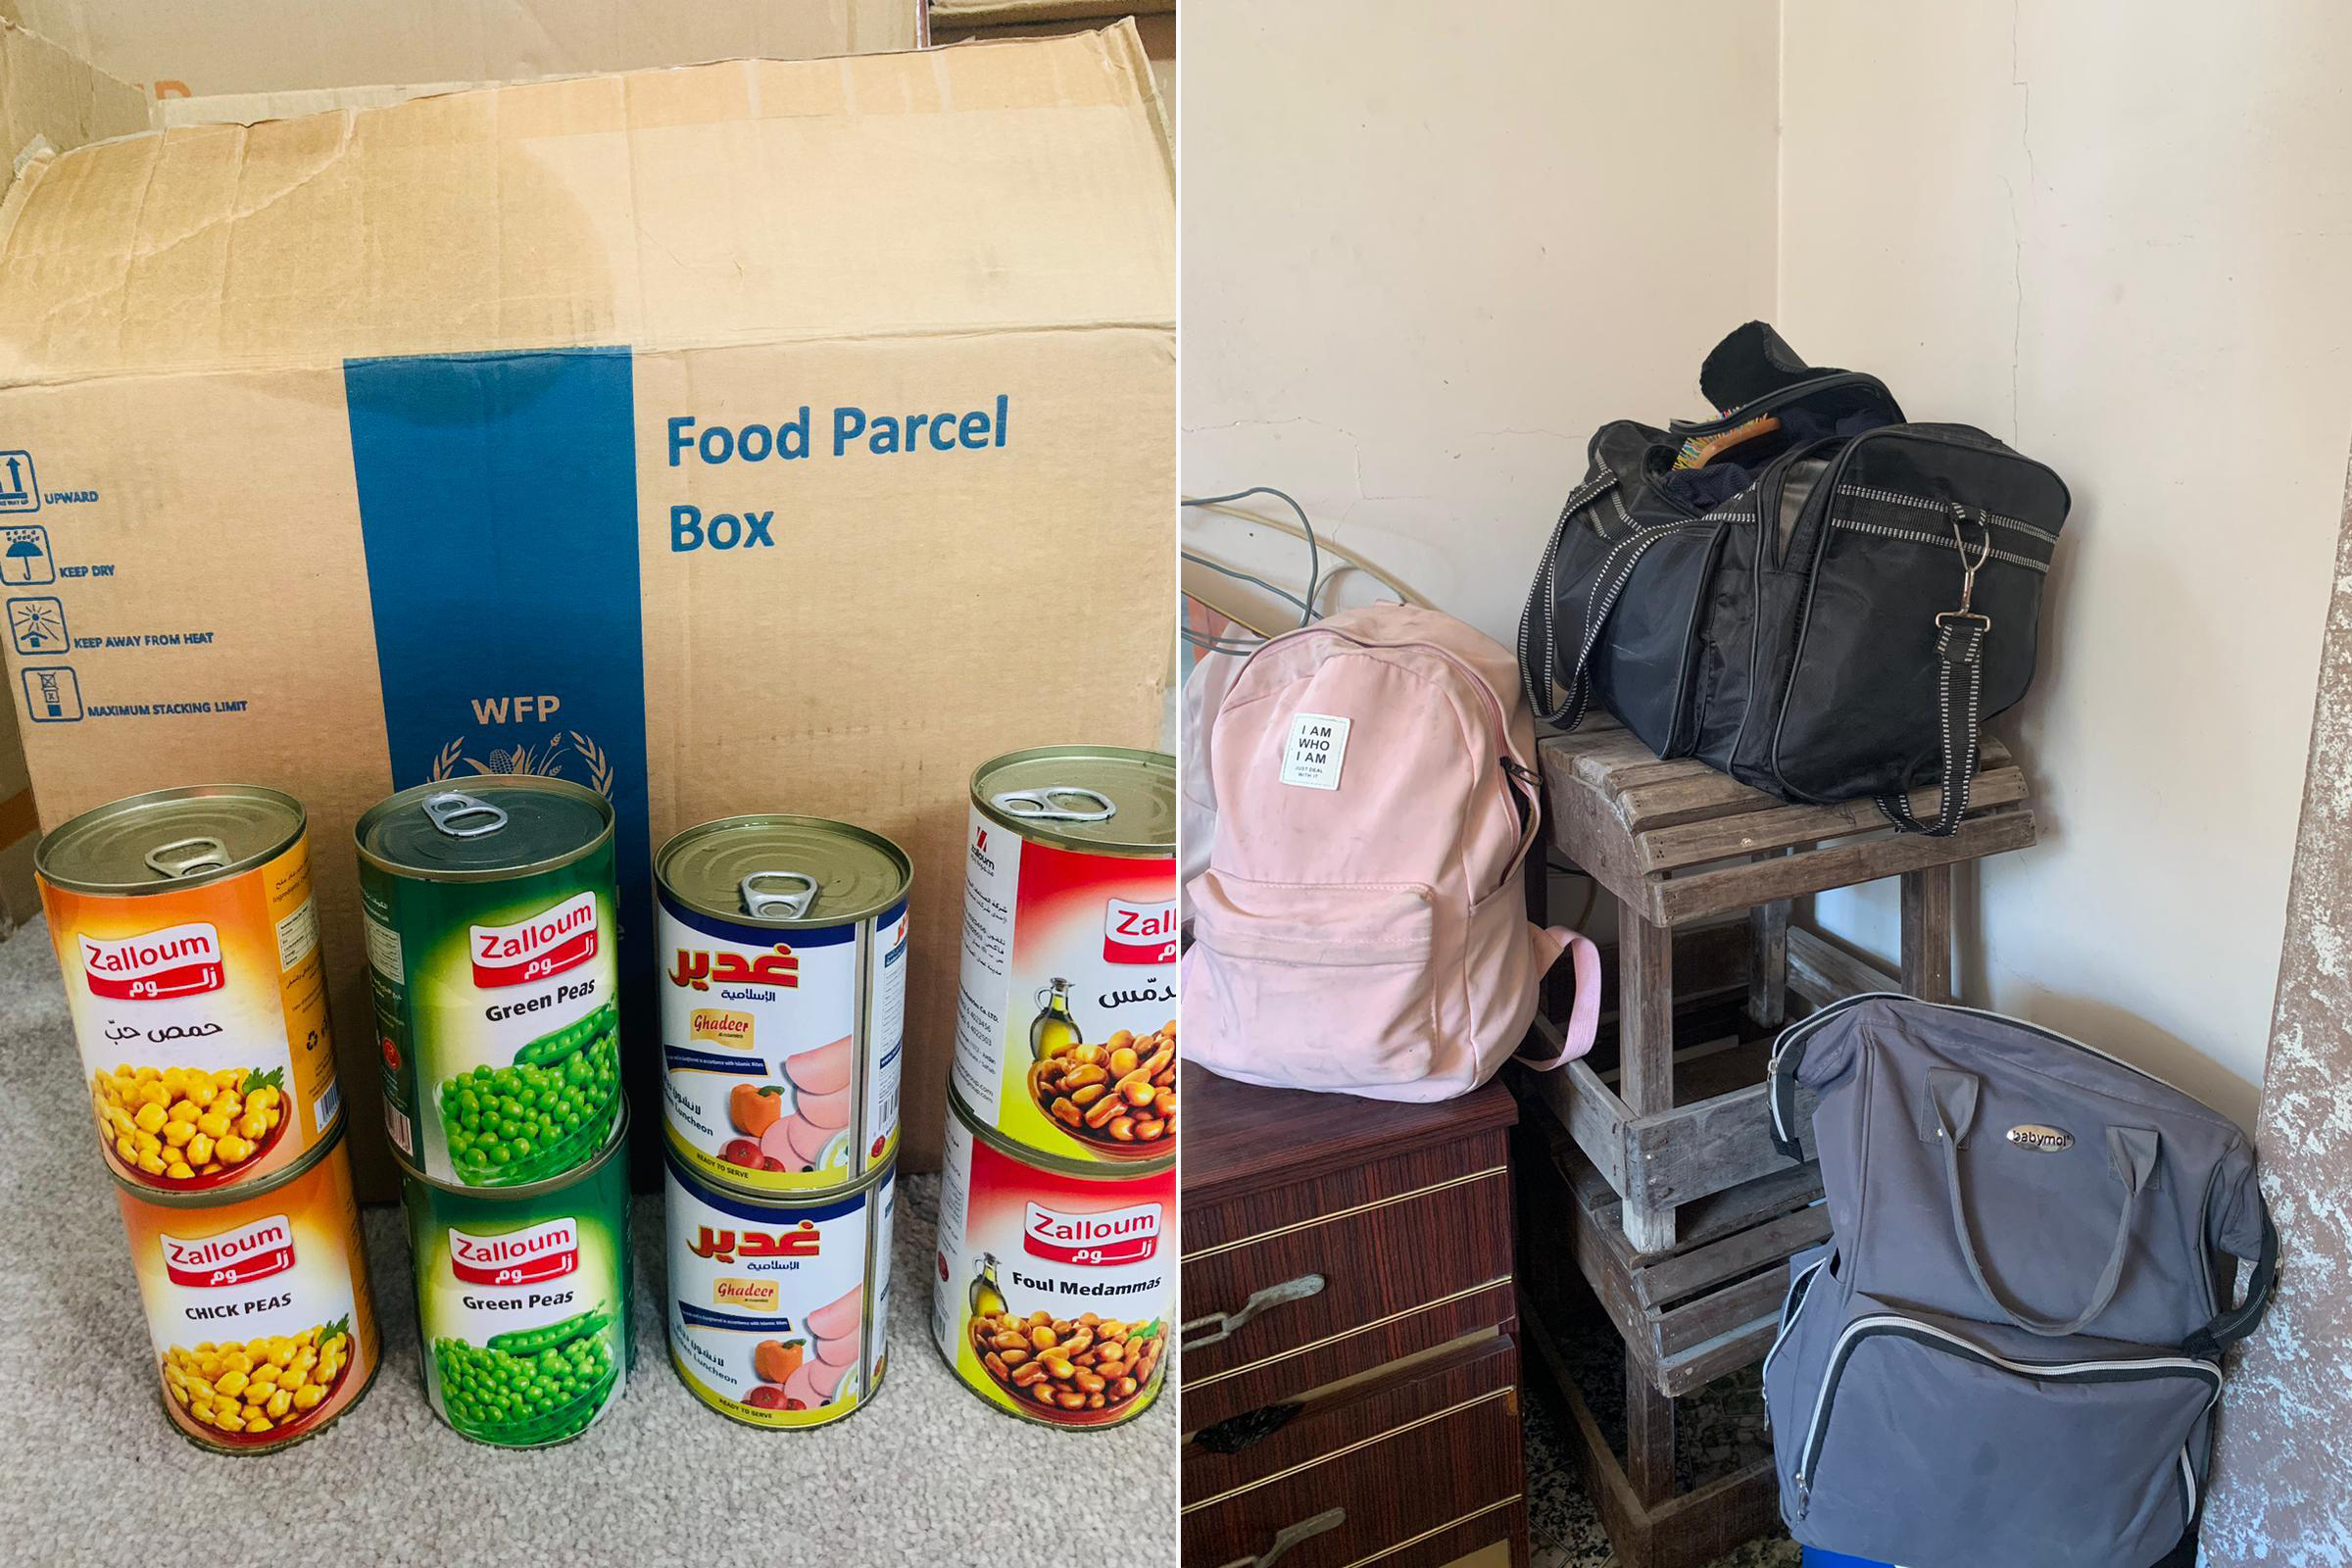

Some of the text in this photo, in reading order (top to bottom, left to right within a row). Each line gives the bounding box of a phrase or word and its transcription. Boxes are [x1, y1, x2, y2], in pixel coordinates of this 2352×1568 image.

[667, 394, 1008, 466] Food Parcel
[44, 491, 99, 505] UPWARD
[669, 505, 775, 552] Box
[60, 564, 115, 578] KEEP DRY
[74, 632, 214, 649] KEEP AWAY FROM HEAT
[87, 701, 248, 716] MAXIMUM STACKING LIMIT
[471, 695, 561, 725] WFP
[1298, 738, 1330, 752] WHO
[1301, 725, 1332, 738] I AM
[1296, 751, 1327, 764] I AM
[479, 905, 592, 959] Zalloum
[85, 935, 210, 971] Zalloum
[668, 942, 800, 992] غدير
[484, 978, 596, 1022] Green Peas
[147, 1019, 223, 1044] حمص
[694, 1013, 749, 1032] Ghadeer
[674, 1102, 713, 1136] Luncheon
[697, 1152, 749, 1179] READY TO SERVE
[1033, 1212, 1154, 1241] Zalloum
[168, 1226, 283, 1265] Zalloum
[456, 1228, 570, 1262] Zalloum
[686, 1219, 820, 1264] غدير
[717, 1283, 774, 1298] Ghadeer
[1012, 1271, 1160, 1296] Foul Medammas
[185, 1293, 292, 1320] CHICK PEAS
[463, 1291, 574, 1310] Green Peas
[693, 1352, 738, 1385] Luncheon
[718, 1397, 740, 1411] READY
[751, 1410, 772, 1419] SERVE
